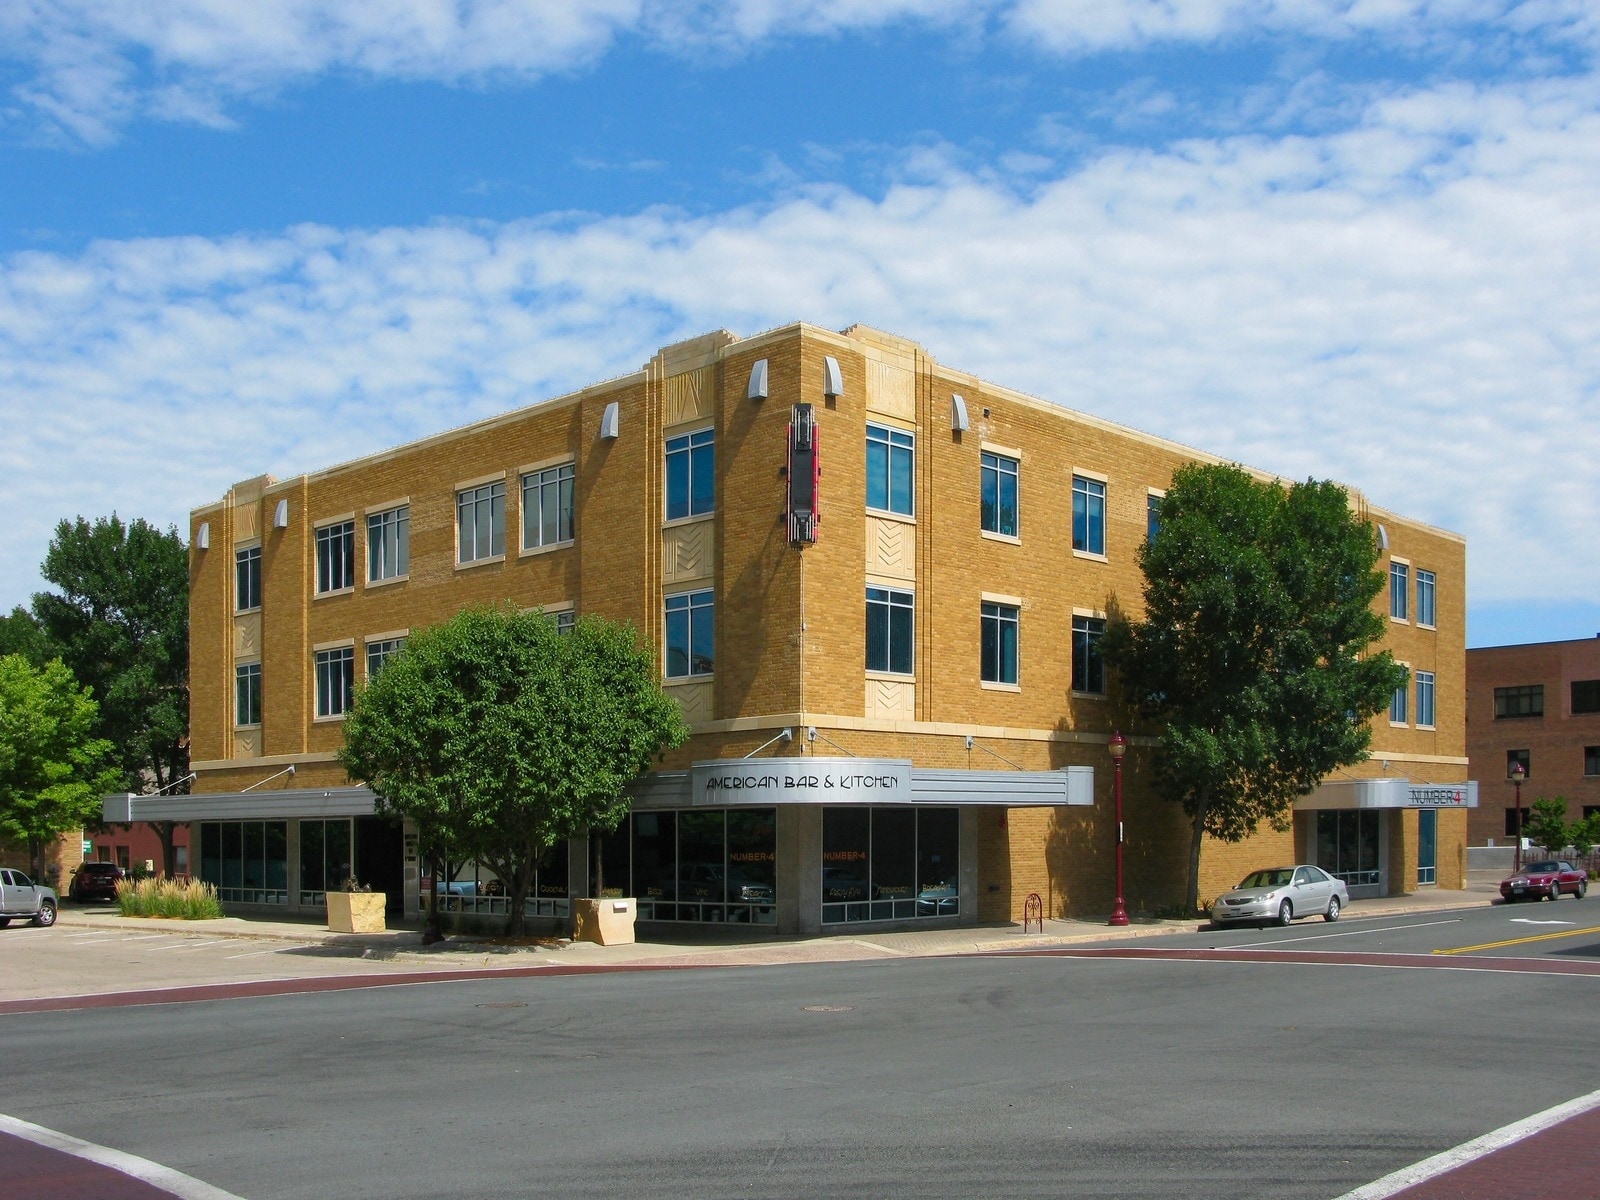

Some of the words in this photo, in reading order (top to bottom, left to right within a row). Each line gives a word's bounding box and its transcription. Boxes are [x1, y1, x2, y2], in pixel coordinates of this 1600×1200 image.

[706, 775, 779, 790] AMERICAN
[784, 775, 819, 789] BAR
[823, 774, 835, 789] &
[840, 775, 898, 790] KITCHEN
